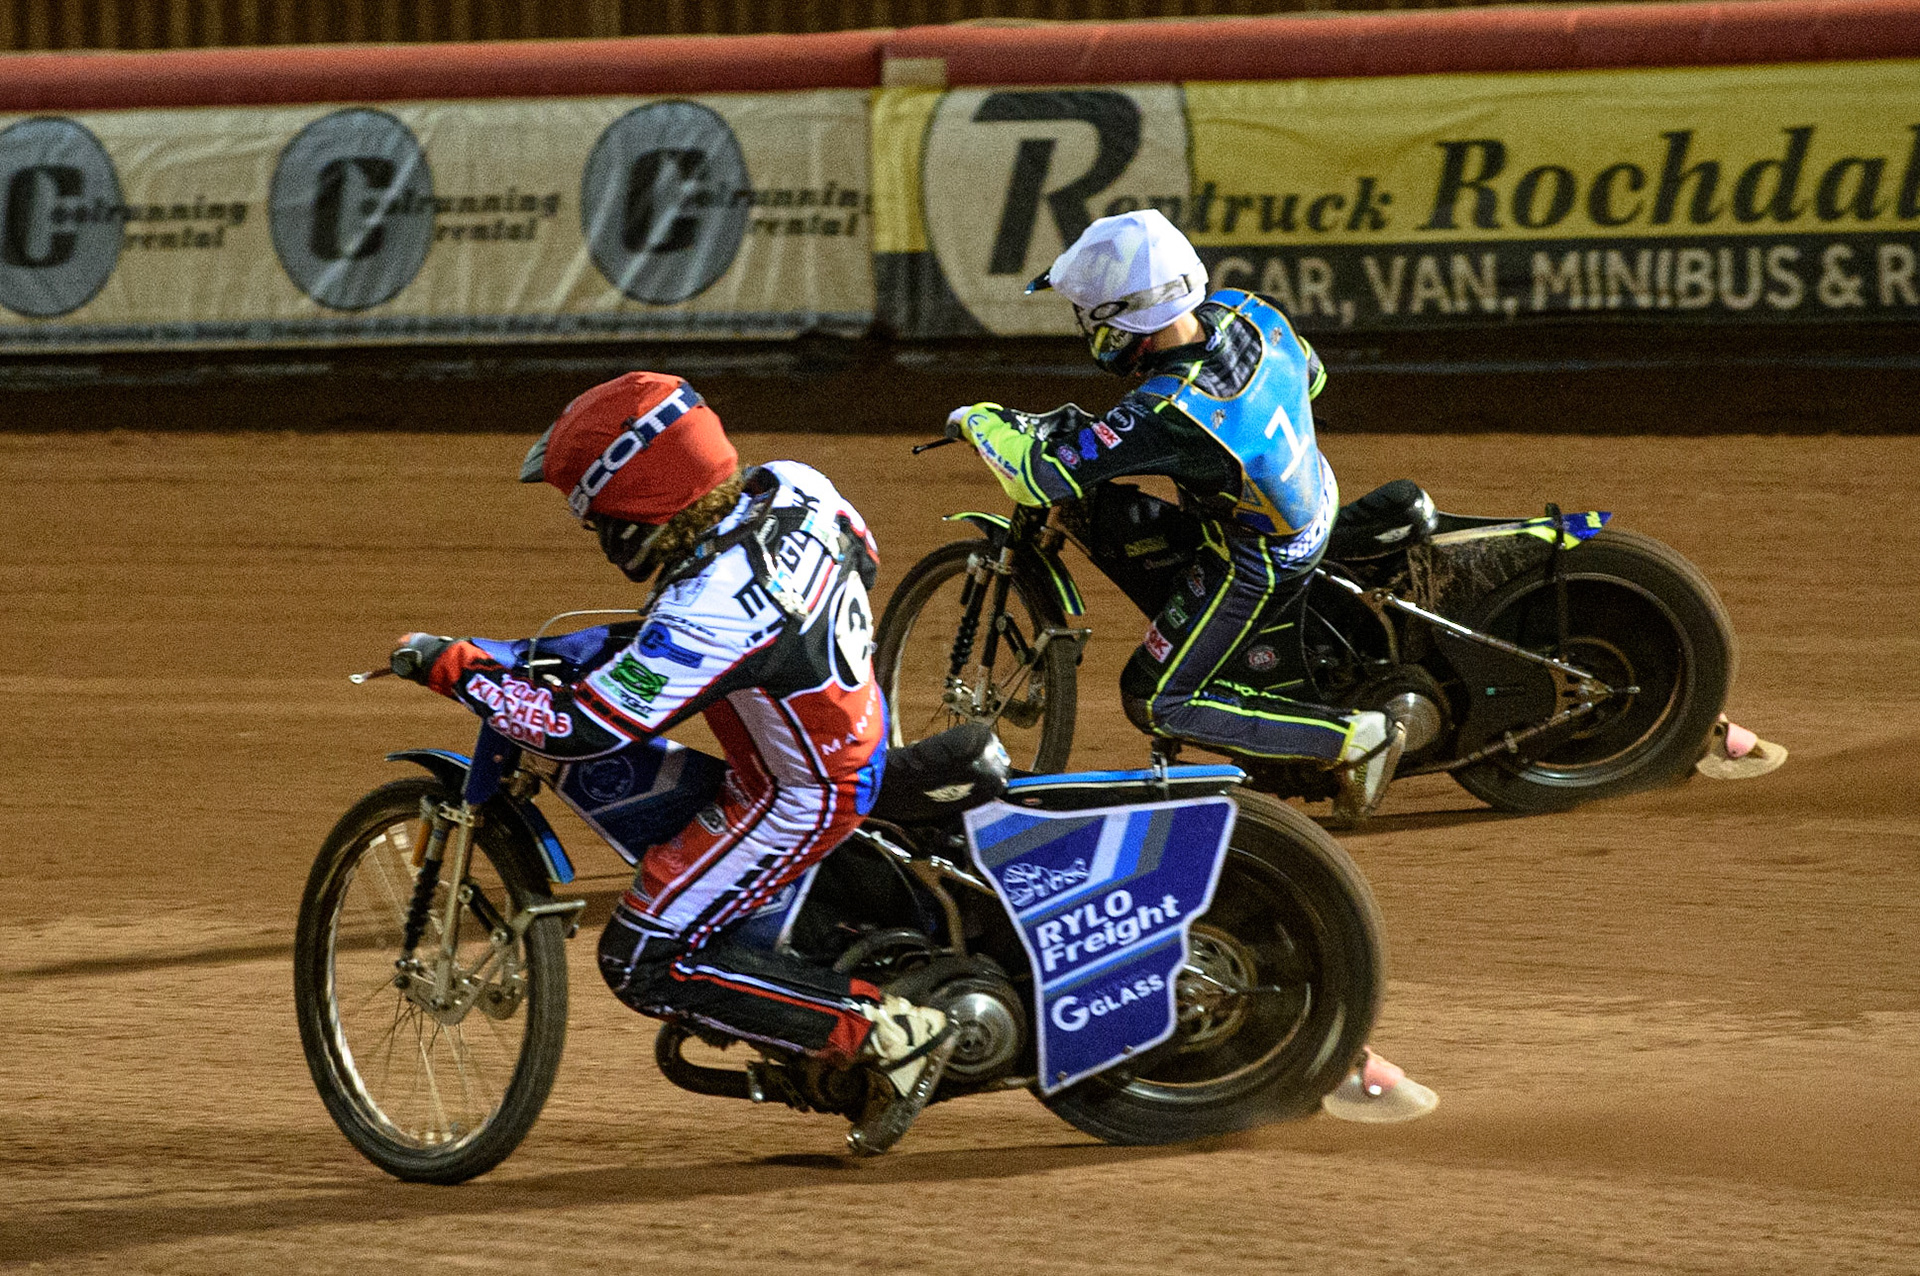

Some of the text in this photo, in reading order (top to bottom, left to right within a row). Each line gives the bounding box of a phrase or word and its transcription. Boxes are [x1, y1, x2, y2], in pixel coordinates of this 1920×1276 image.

[1364, 253, 1517, 320] VAN,
[1531, 246, 1804, 310] MINIBUS
[1817, 244, 1865, 308] &
[568, 388, 690, 519] SCOTT
[1264, 405, 1310, 482] 1
[1037, 889, 1133, 949] RYLO
[1042, 895, 1182, 973] Freight
